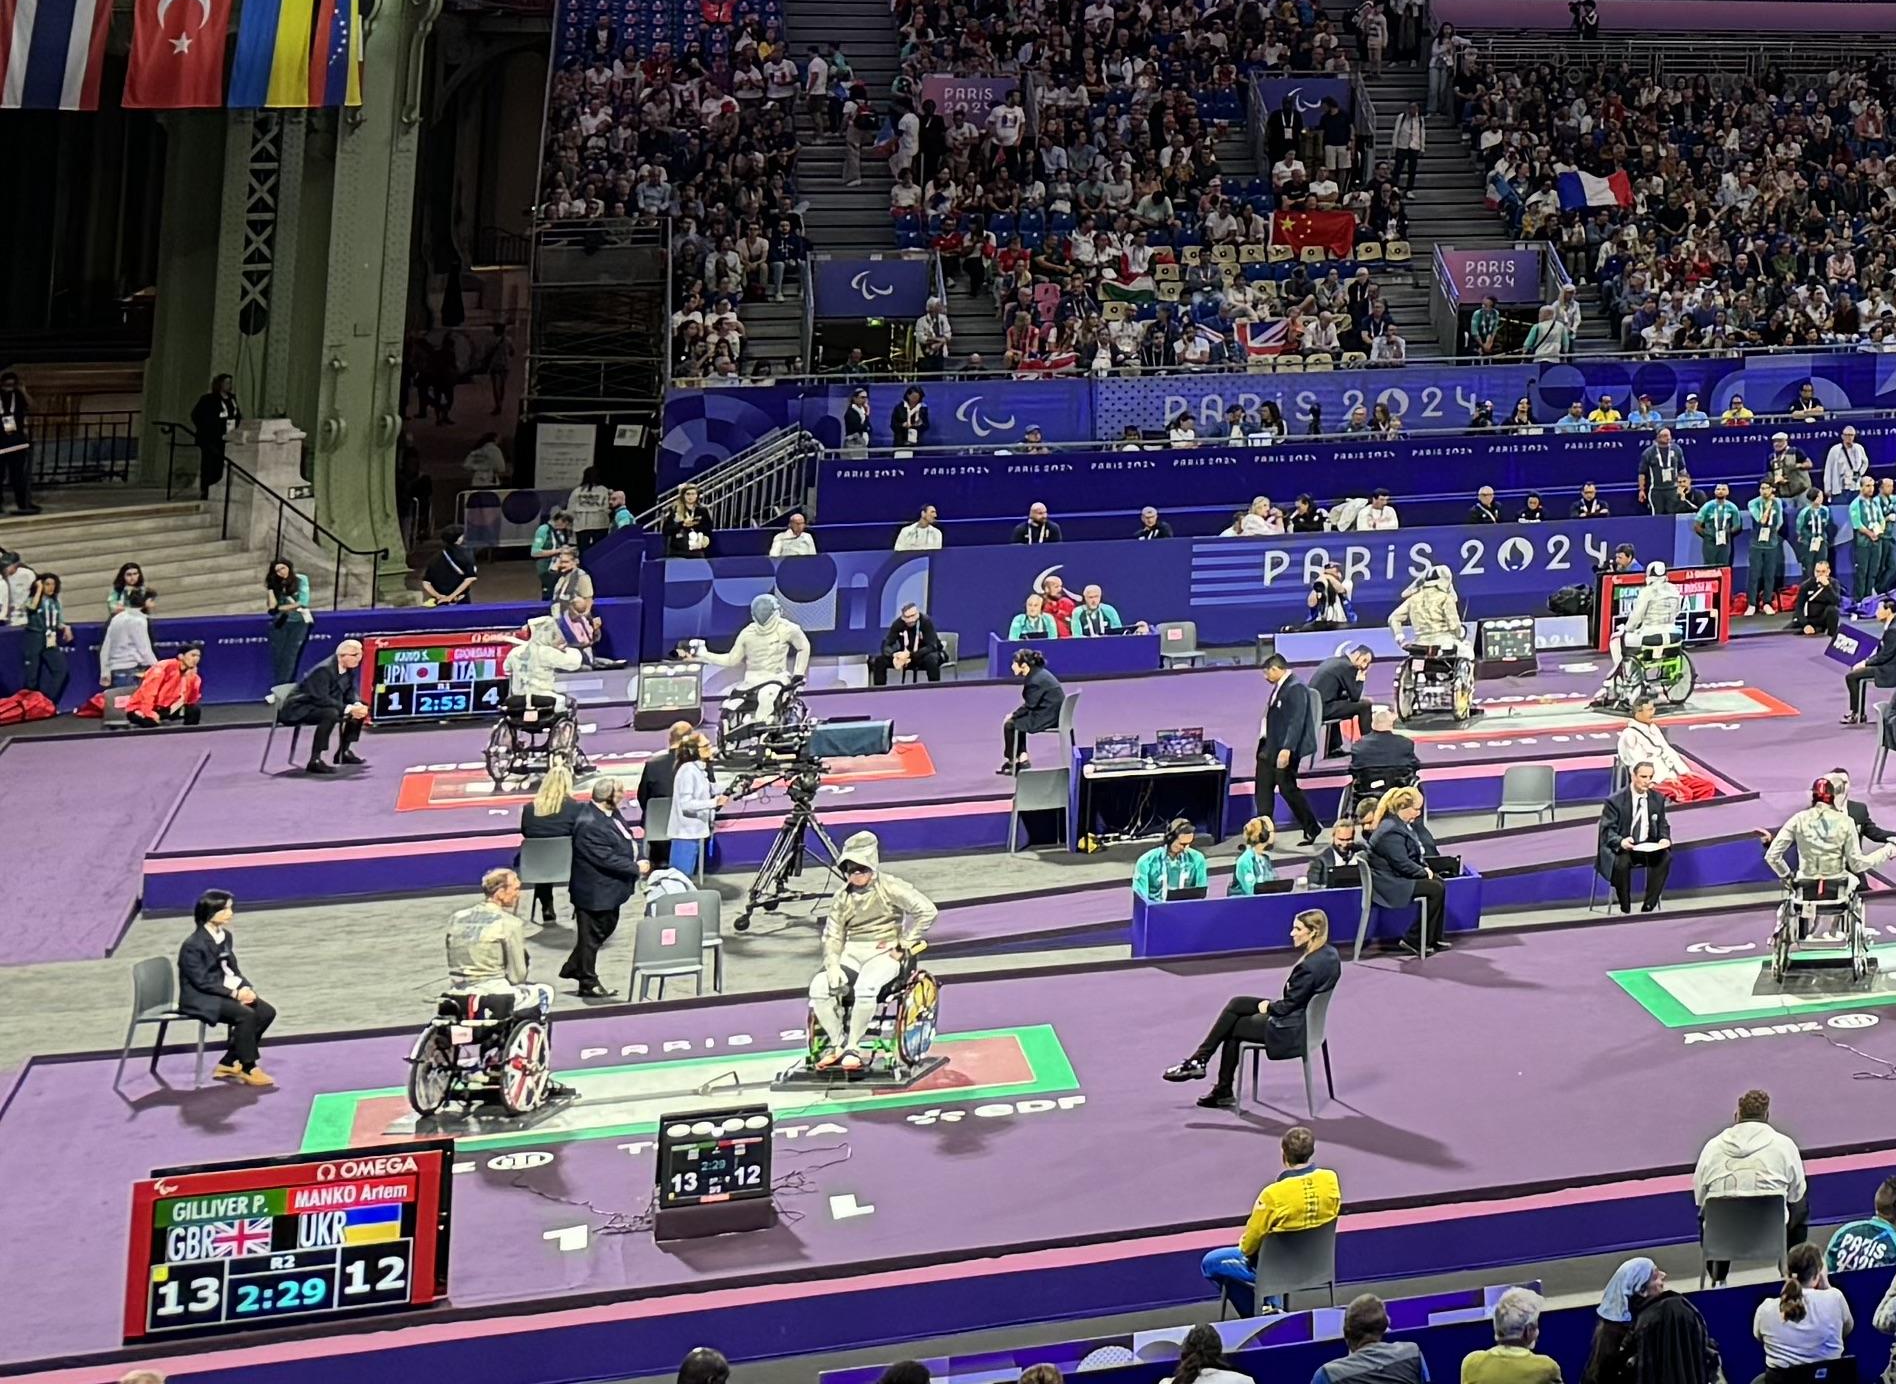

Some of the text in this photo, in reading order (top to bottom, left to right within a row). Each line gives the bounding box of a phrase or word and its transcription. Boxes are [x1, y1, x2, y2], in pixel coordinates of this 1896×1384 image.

[944, 87, 993, 100] PARIS
[1465, 260, 1515, 273] PARIS
[1465, 275, 1515, 288] 2024
[1164, 392, 1318, 425] PARIS
[1263, 532, 1608, 586] PARIS 2024
[1695, 618, 1709, 634] 7
[384, 664, 407, 683] JPN
[453, 660, 476, 681] ITA
[387, 692, 402, 710] 1
[419, 695, 466, 711] 2:53
[482, 686, 499, 705] 4
[1684, 1018, 1823, 1045] Allianz
[581, 1034, 753, 1060] PARIS
[340, 1156, 419, 1179] OMEGA
[671, 1165, 761, 1193] 13 12
[172, 1195, 269, 1222] GILLIVER P.
[294, 1182, 408, 1209] MANKO Artem
[298, 1209, 347, 1248] UKR
[168, 1224, 217, 1262] GBR
[270, 1255, 296, 1270] R2
[344, 1255, 406, 1295] 12
[156, 1276, 221, 1316] 13
[236, 1277, 327, 1313] 2:29
